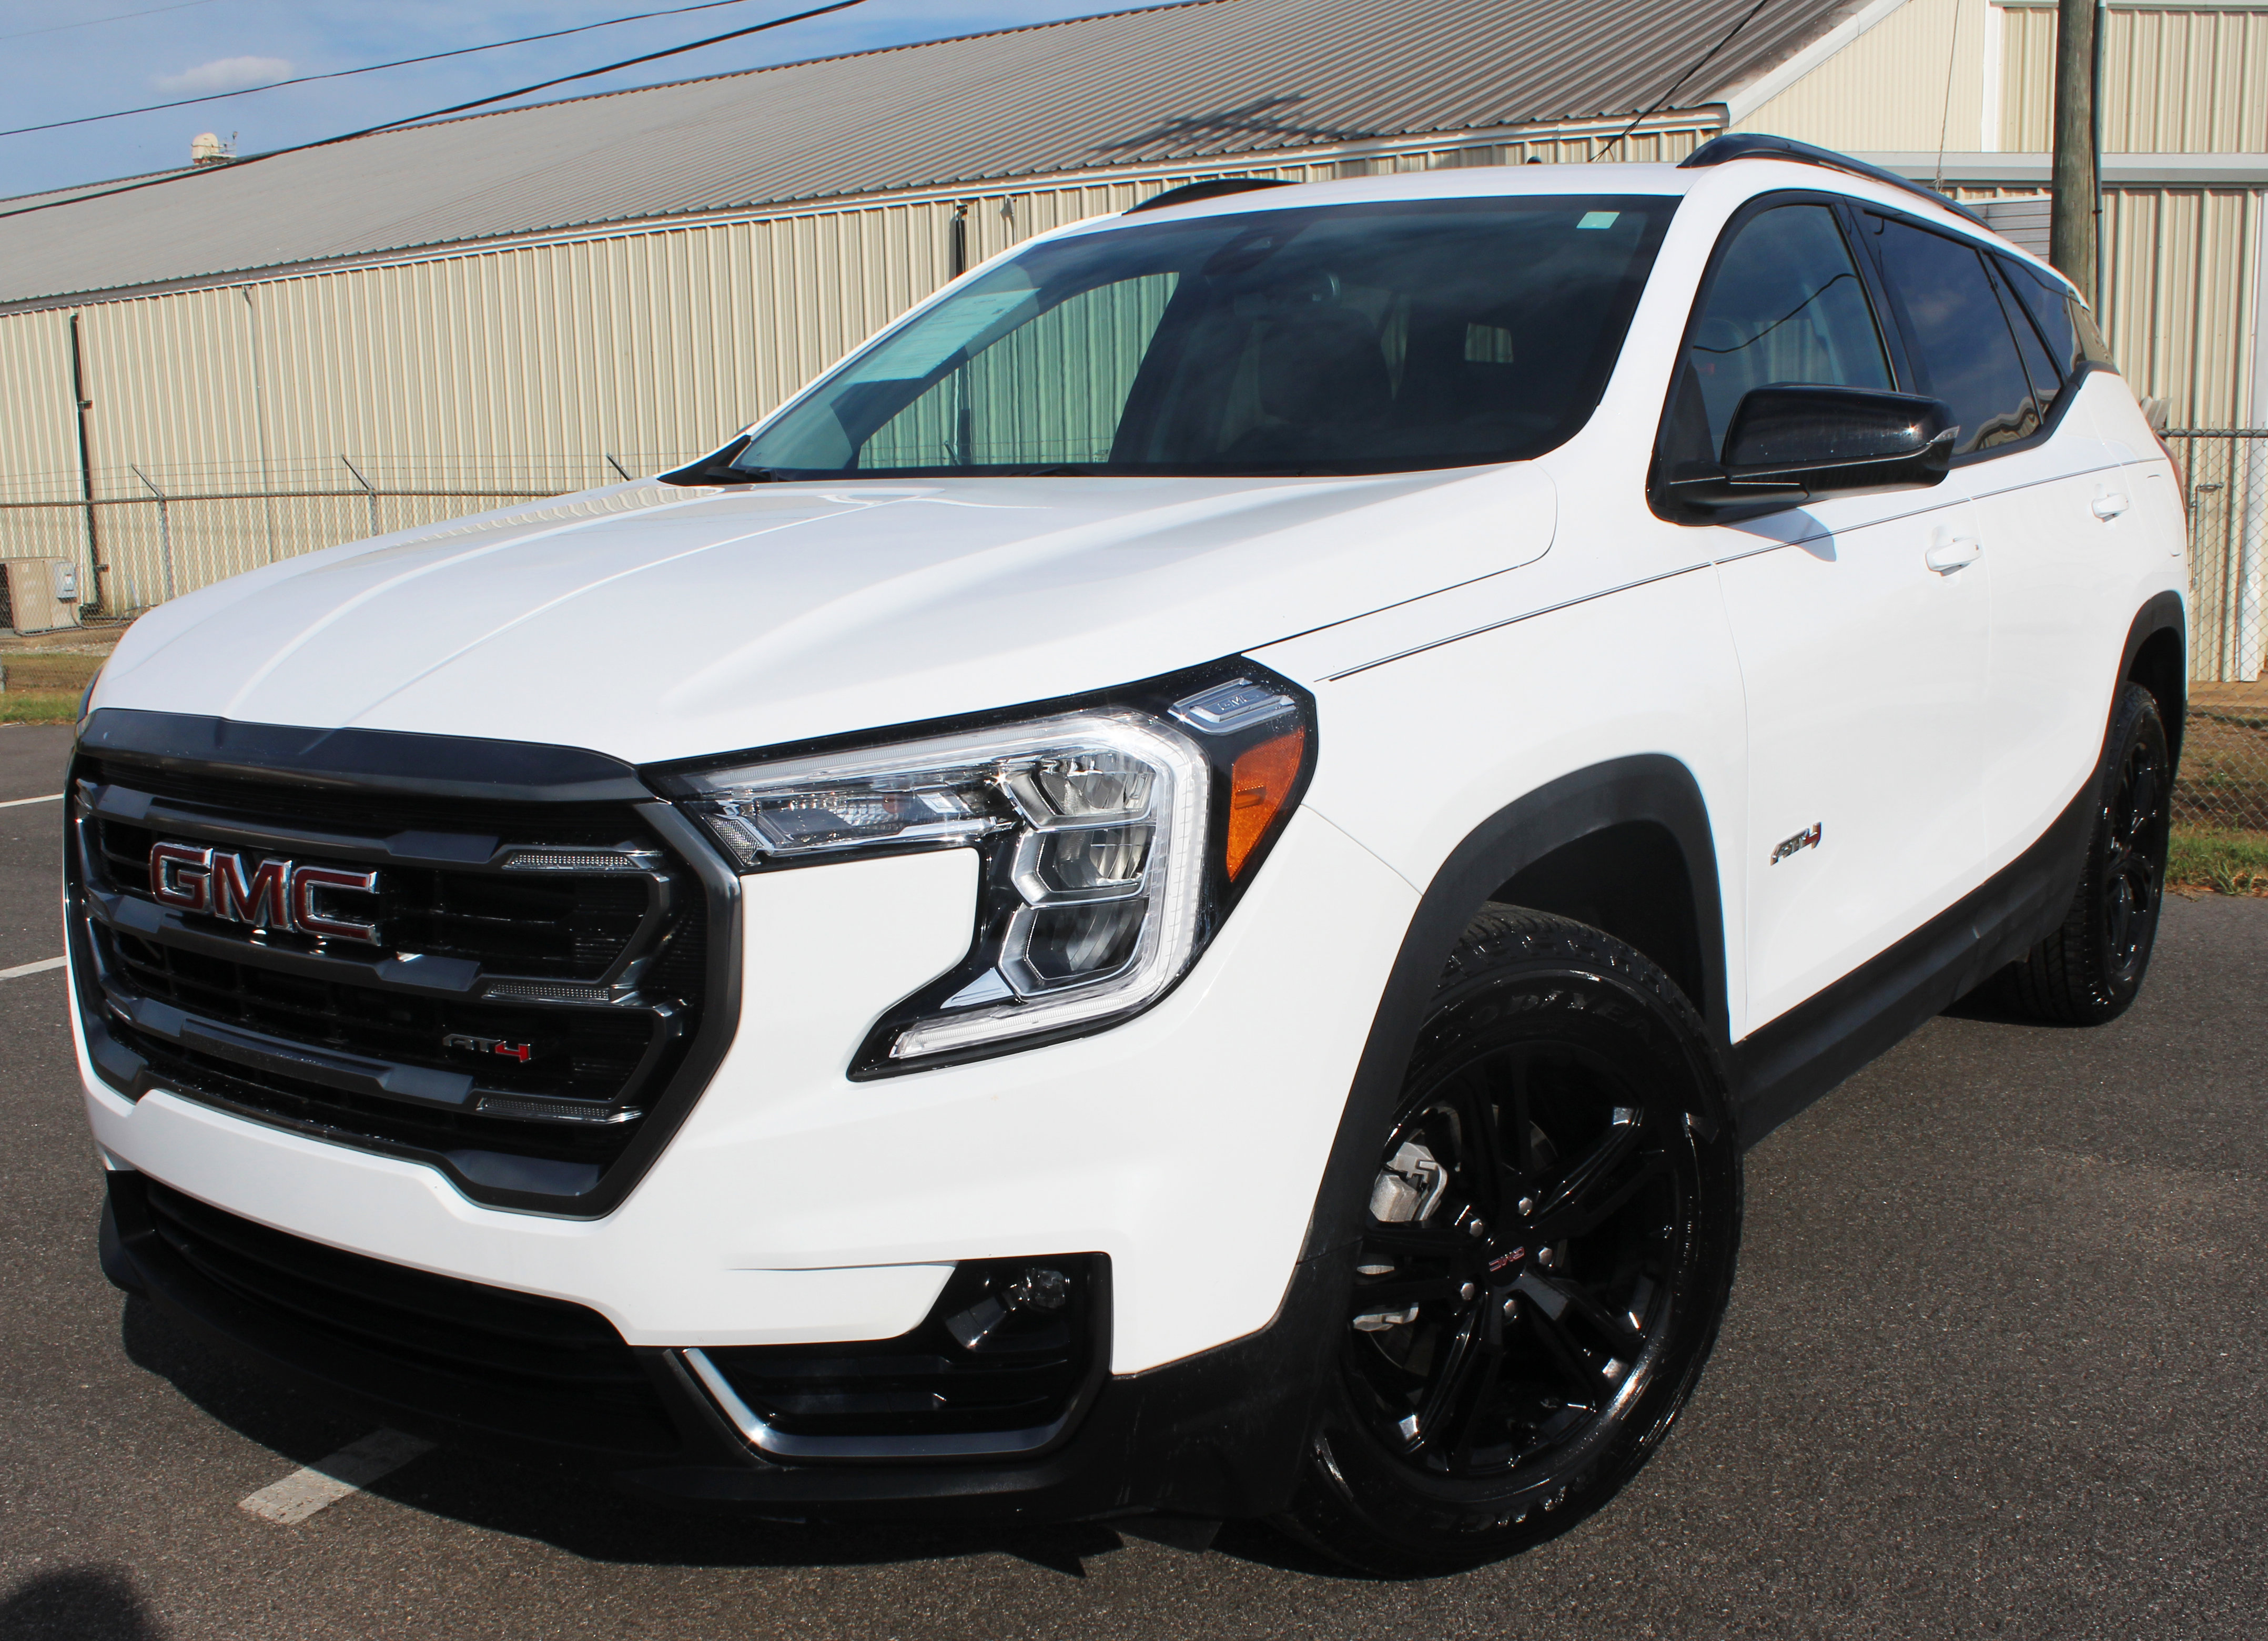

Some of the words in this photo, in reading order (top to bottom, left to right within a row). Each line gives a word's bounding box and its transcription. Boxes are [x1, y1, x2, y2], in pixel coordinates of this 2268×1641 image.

[149, 842, 382, 946] GMC
[442, 1034, 531, 1062] AT4
[1489, 1245, 1525, 1272] GMC
